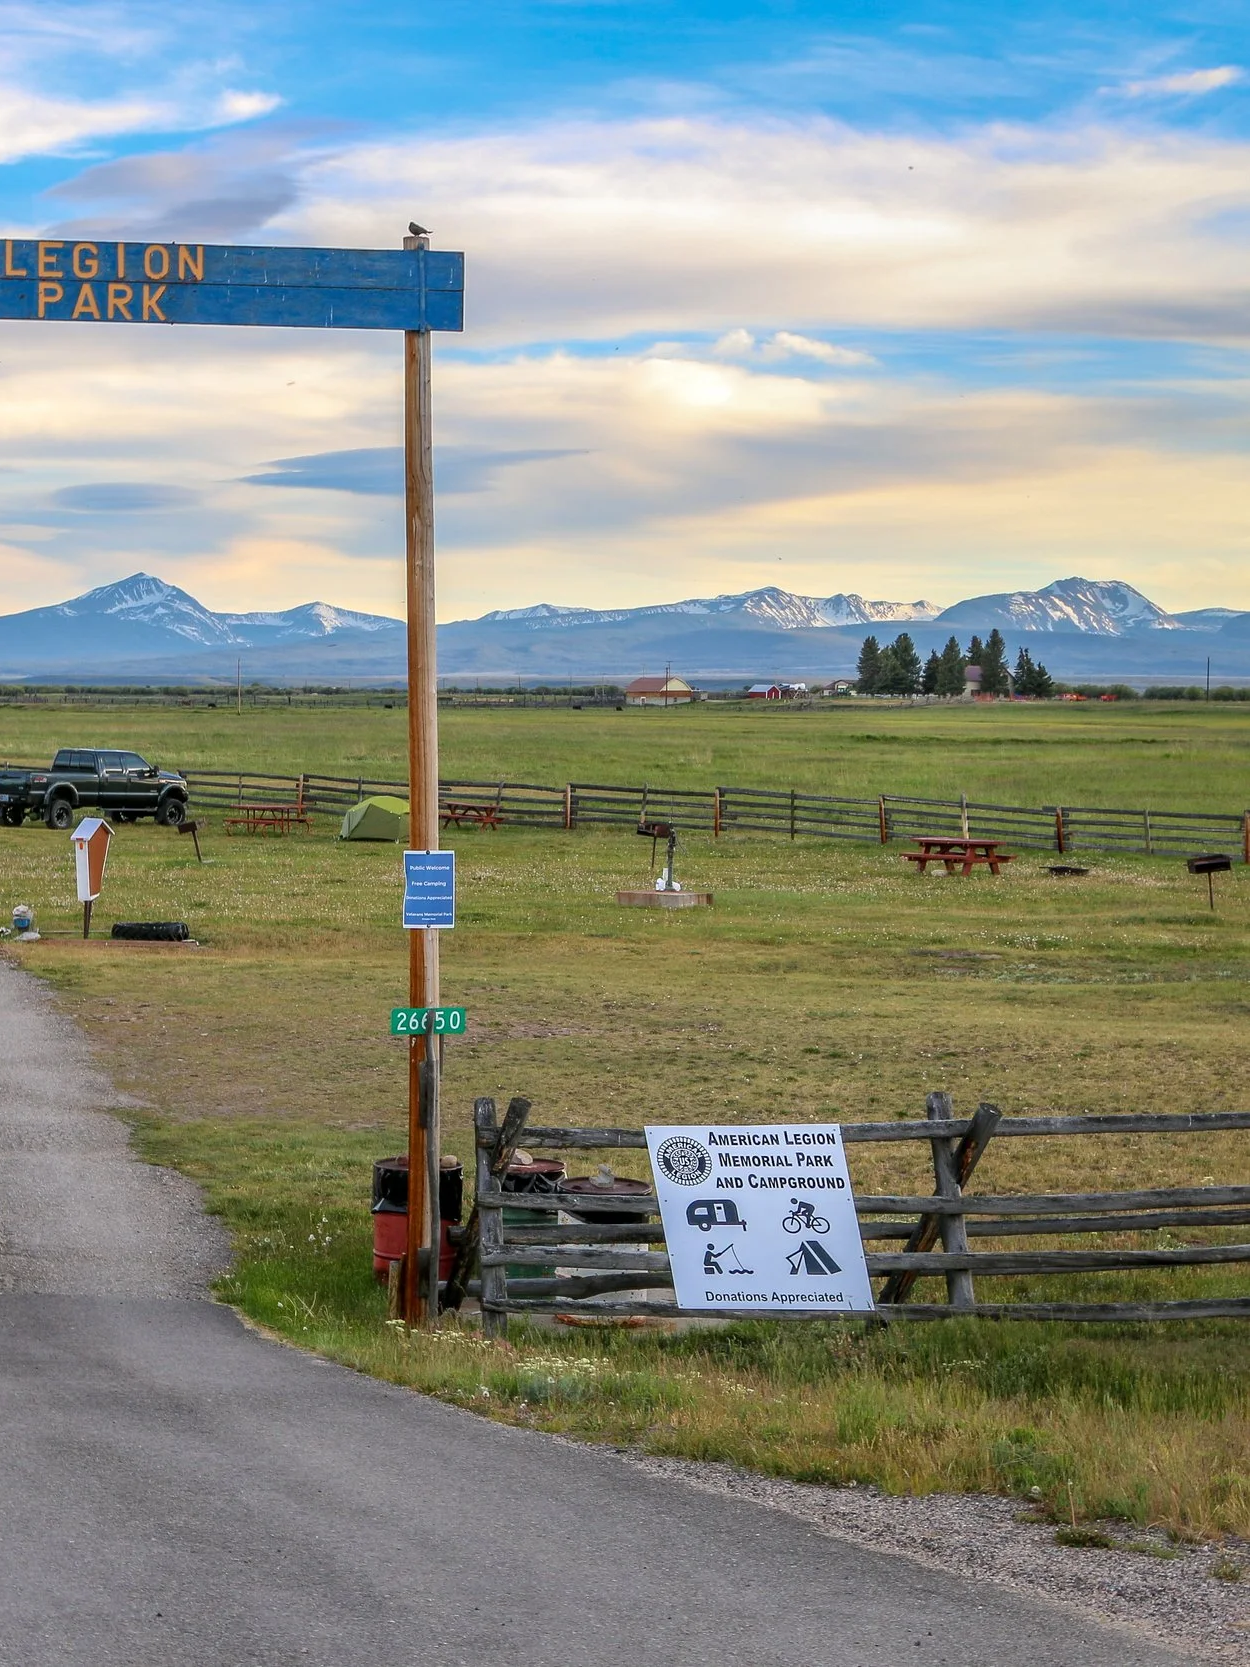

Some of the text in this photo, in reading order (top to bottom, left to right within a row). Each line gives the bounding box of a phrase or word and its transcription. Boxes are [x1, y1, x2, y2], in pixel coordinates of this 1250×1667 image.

[5, 239, 204, 281] LEGION
[37, 281, 167, 322] PARK
[708, 1130, 836, 1146] AMERICAN LEGION
[664, 1142, 703, 1159] AMERICAN
[718, 1152, 834, 1167] MEMORIAL PARK
[671, 1169, 702, 1180] LEGION
[748, 1174, 845, 1189] CAMPGROUND
[705, 1290, 844, 1304] Donations Appreciated
